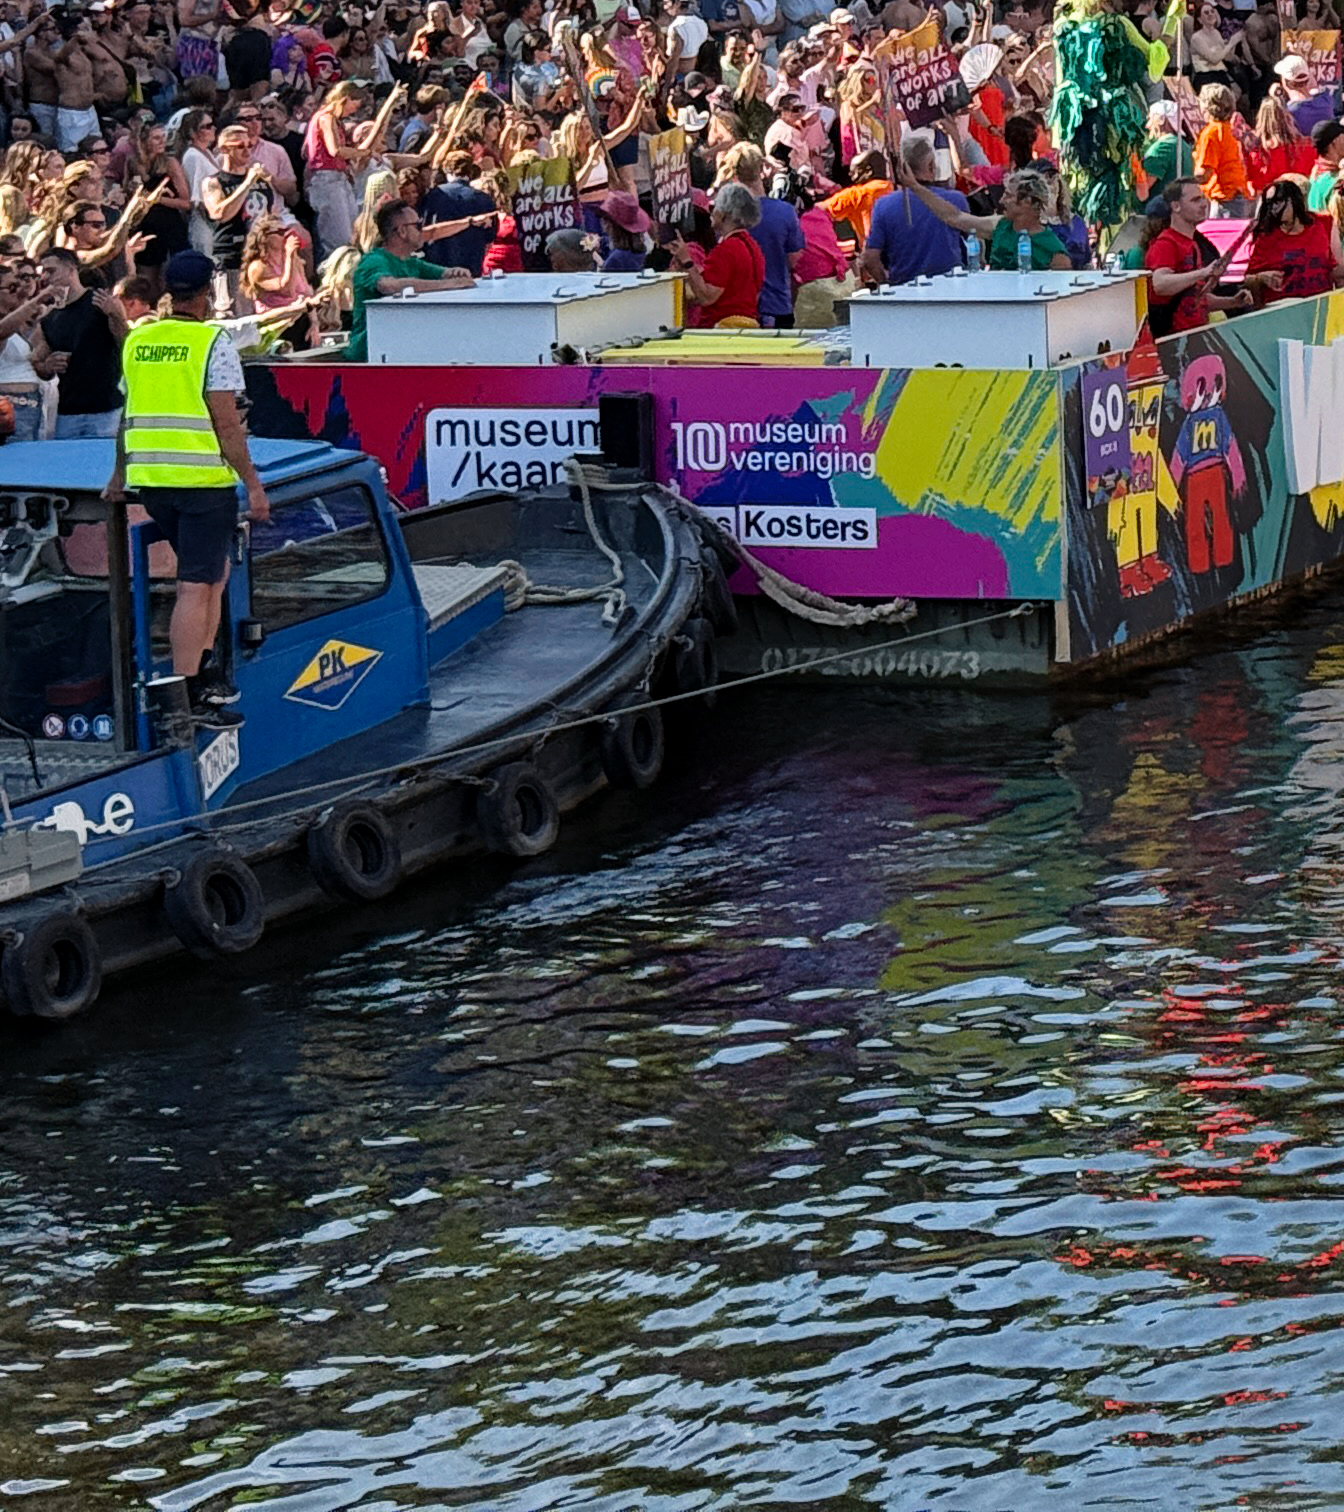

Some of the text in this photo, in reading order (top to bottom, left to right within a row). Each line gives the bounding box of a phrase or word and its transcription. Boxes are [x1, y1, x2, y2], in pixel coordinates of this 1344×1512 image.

[135, 345, 190, 362] SCHIPPER
[1090, 384, 1124, 437] 60
[435, 419, 600, 448] museum
[730, 421, 847, 445] museum
[731, 443, 877, 479] vereniging
[744, 510, 870, 541] Kosters
[319, 646, 348, 681] PK
